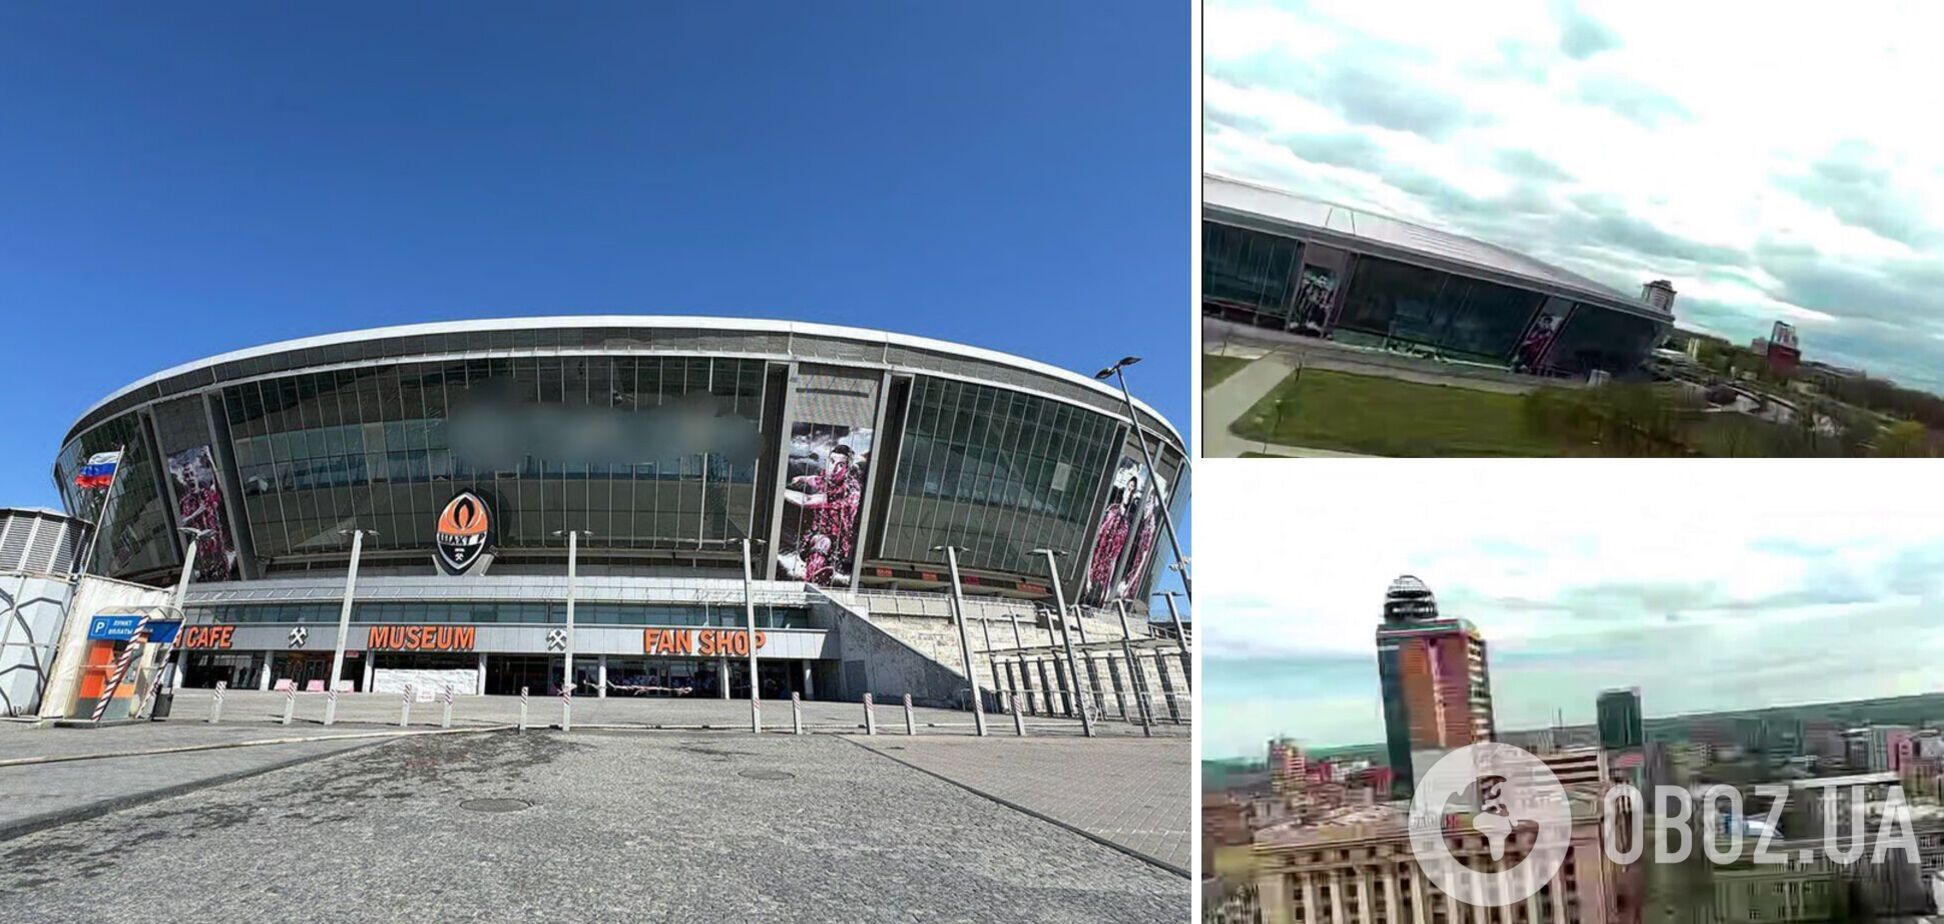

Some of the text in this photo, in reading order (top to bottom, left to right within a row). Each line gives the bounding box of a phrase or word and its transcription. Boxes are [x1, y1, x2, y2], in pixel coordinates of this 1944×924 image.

[186, 626, 234, 648] CAFE
[369, 625, 475, 650] MUSEUM
[644, 629, 766, 656] FAN SHOP
